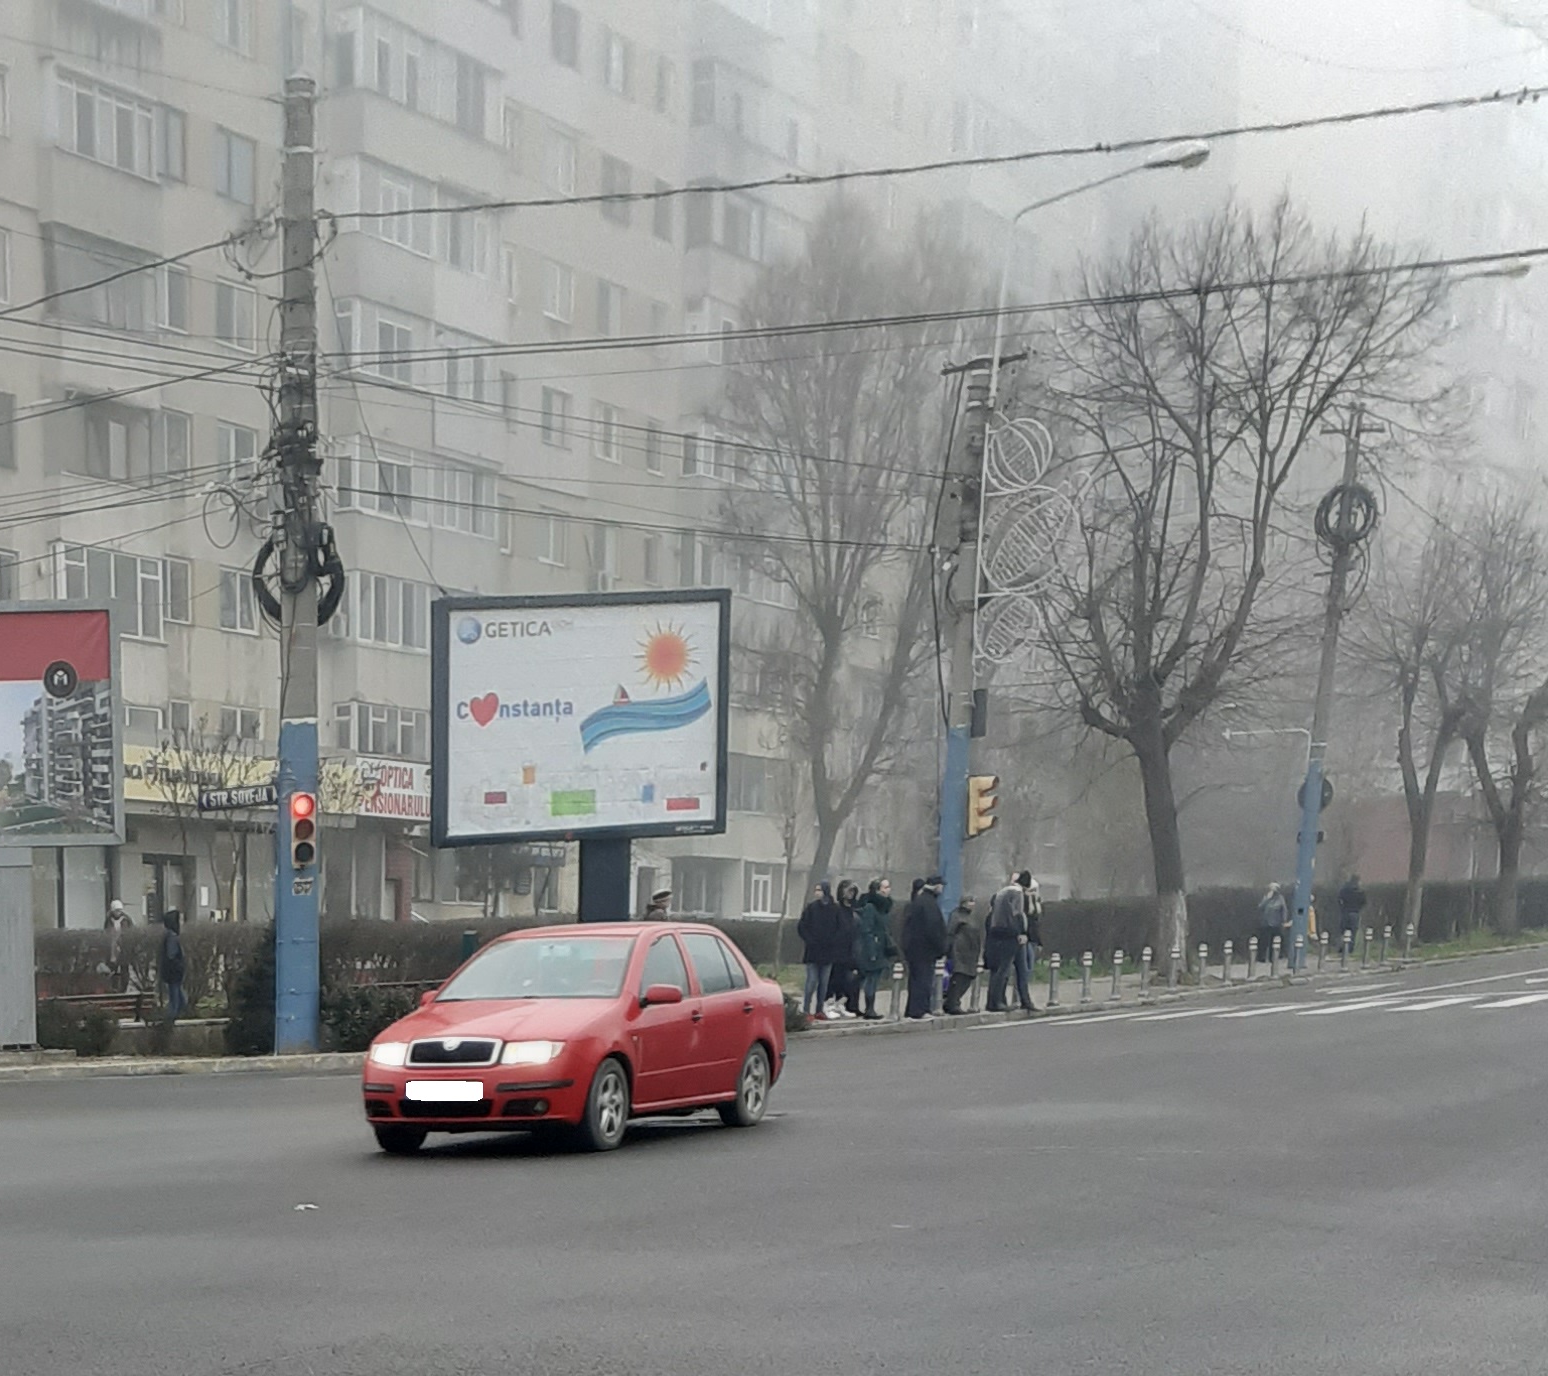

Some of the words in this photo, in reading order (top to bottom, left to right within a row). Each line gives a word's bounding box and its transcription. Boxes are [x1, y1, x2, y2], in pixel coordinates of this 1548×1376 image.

[484, 620, 552, 638] GETICA
[456, 692, 574, 727] Cnstanța
[379, 765, 415, 790] OPTICA
